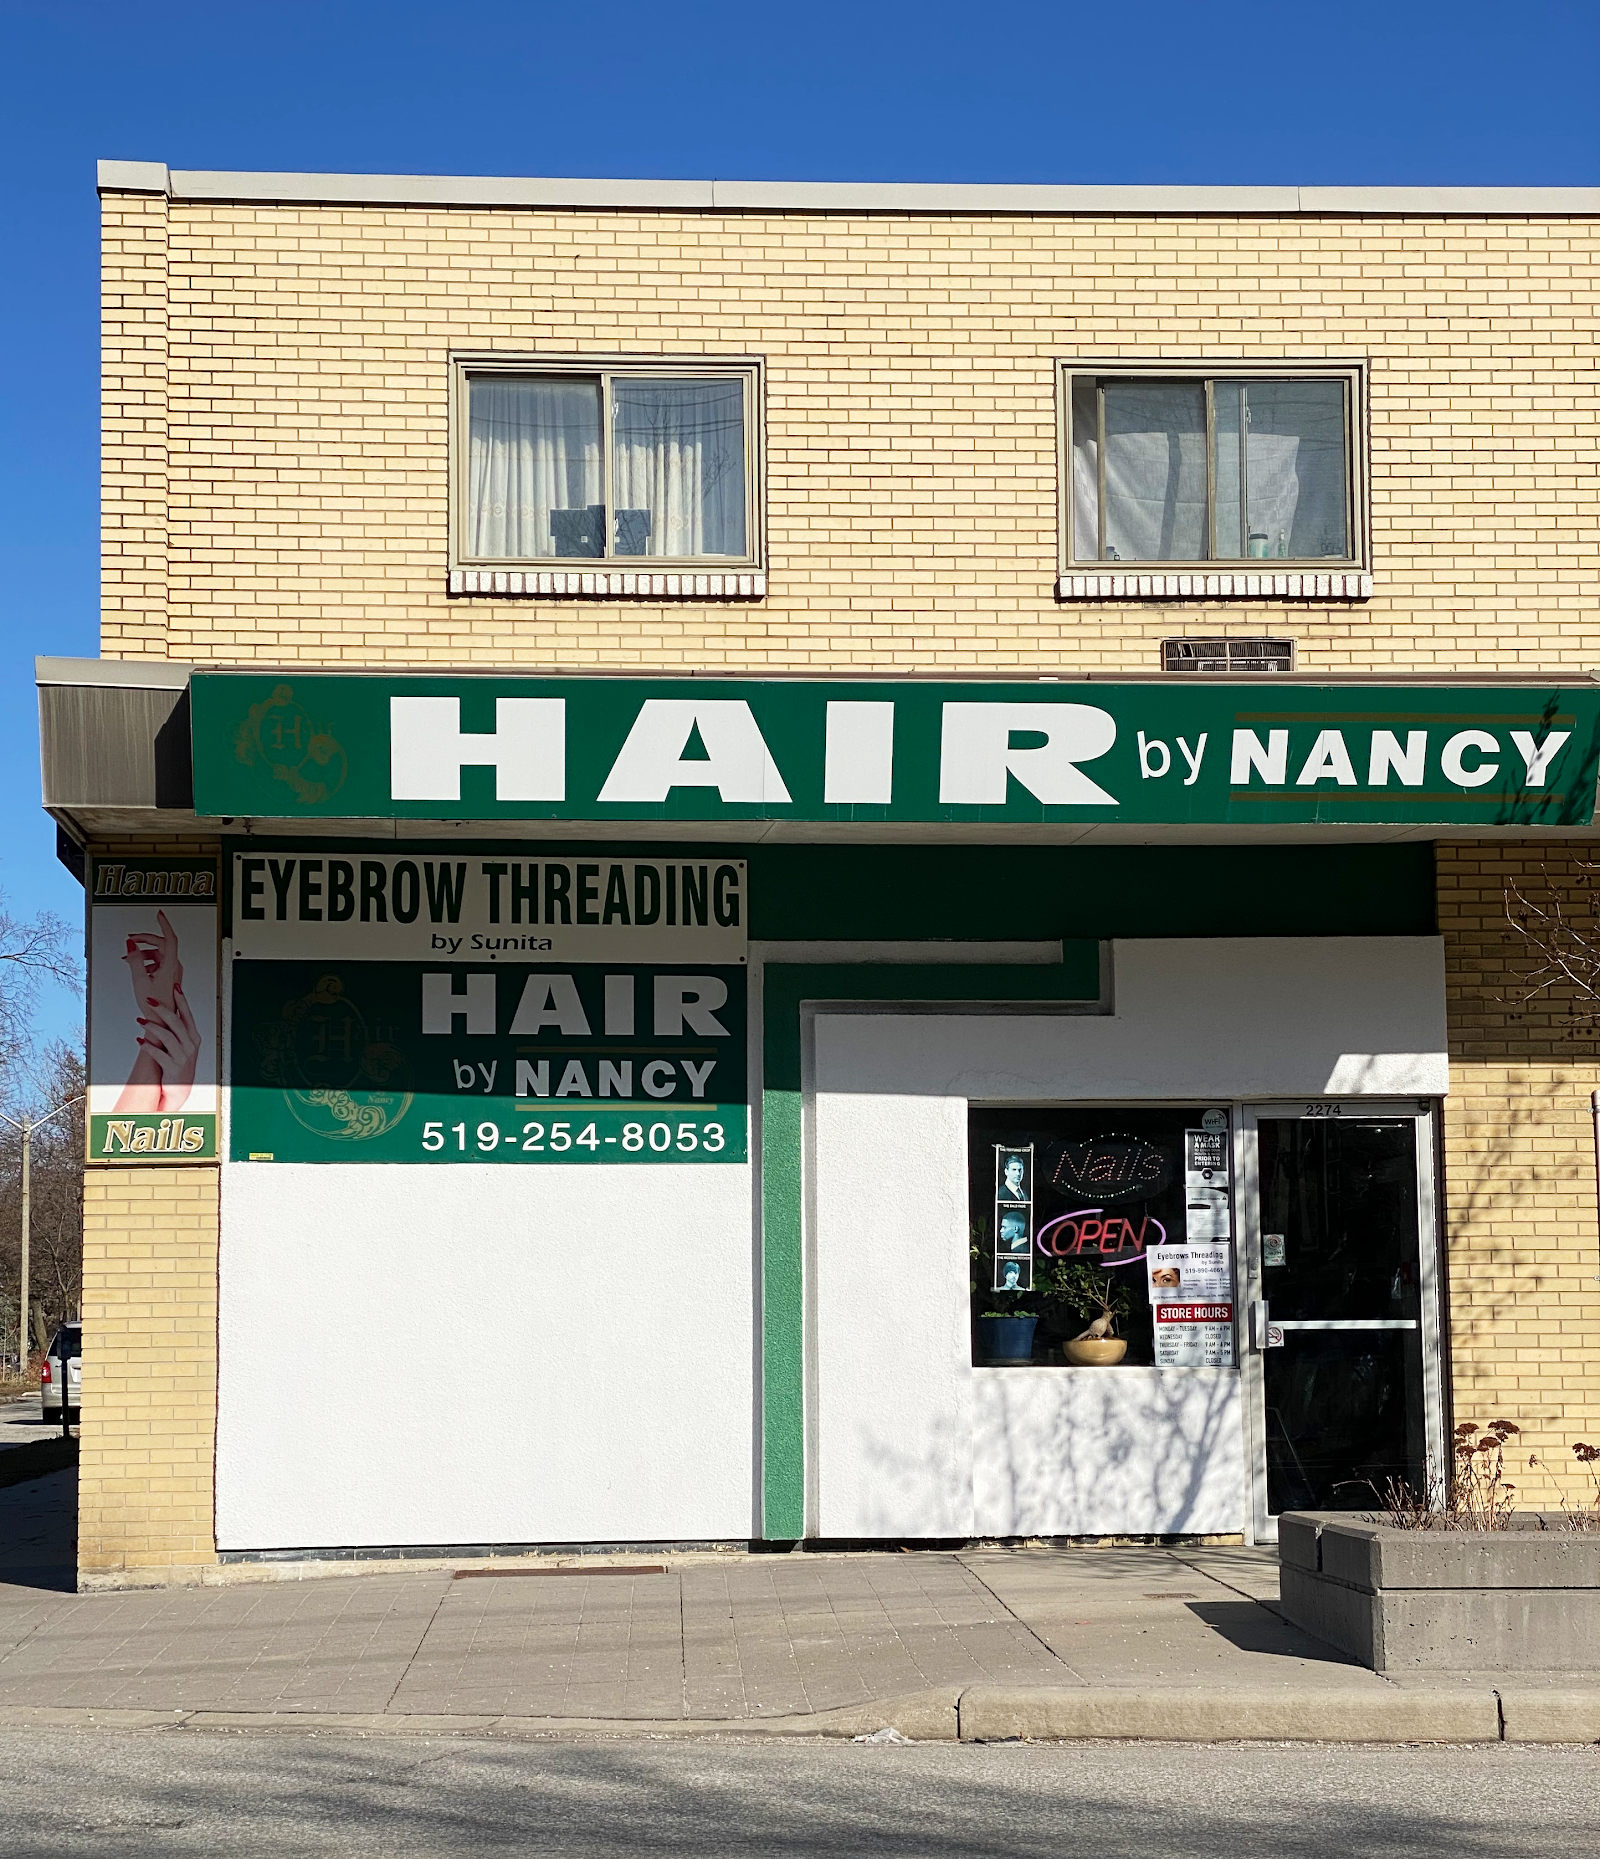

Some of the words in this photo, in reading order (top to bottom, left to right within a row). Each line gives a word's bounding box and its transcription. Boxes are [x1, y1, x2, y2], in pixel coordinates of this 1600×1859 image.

[390, 696, 1119, 806] HAIR
[1136, 730, 1208, 786] by
[1229, 729, 1572, 788] NANCY
[94, 864, 215, 897] Hanna
[240, 858, 467, 925] EYEBROW
[481, 861, 741, 928] THREADING
[430, 933, 464, 955] by
[470, 933, 553, 951] Sunita
[422, 973, 731, 1036] HAIR
[453, 1058, 498, 1093] by
[515, 1059, 717, 1098] NANCY
[1306, 1104, 1342, 1116] 2274
[102, 1118, 205, 1153] Nails
[421, 1121, 725, 1152] 519-254-8053
[1194, 1134, 1221, 1142] WEAR
[1051, 1148, 1164, 1183] Nails
[1051, 1217, 1148, 1256] OPEN
[1157, 1252, 1189, 1261] Eyebrows
[1190, 1251, 1224, 1260] Threading
[1160, 1307, 1192, 1319] STORE
[1194, 1307, 1228, 1318] HOURS
